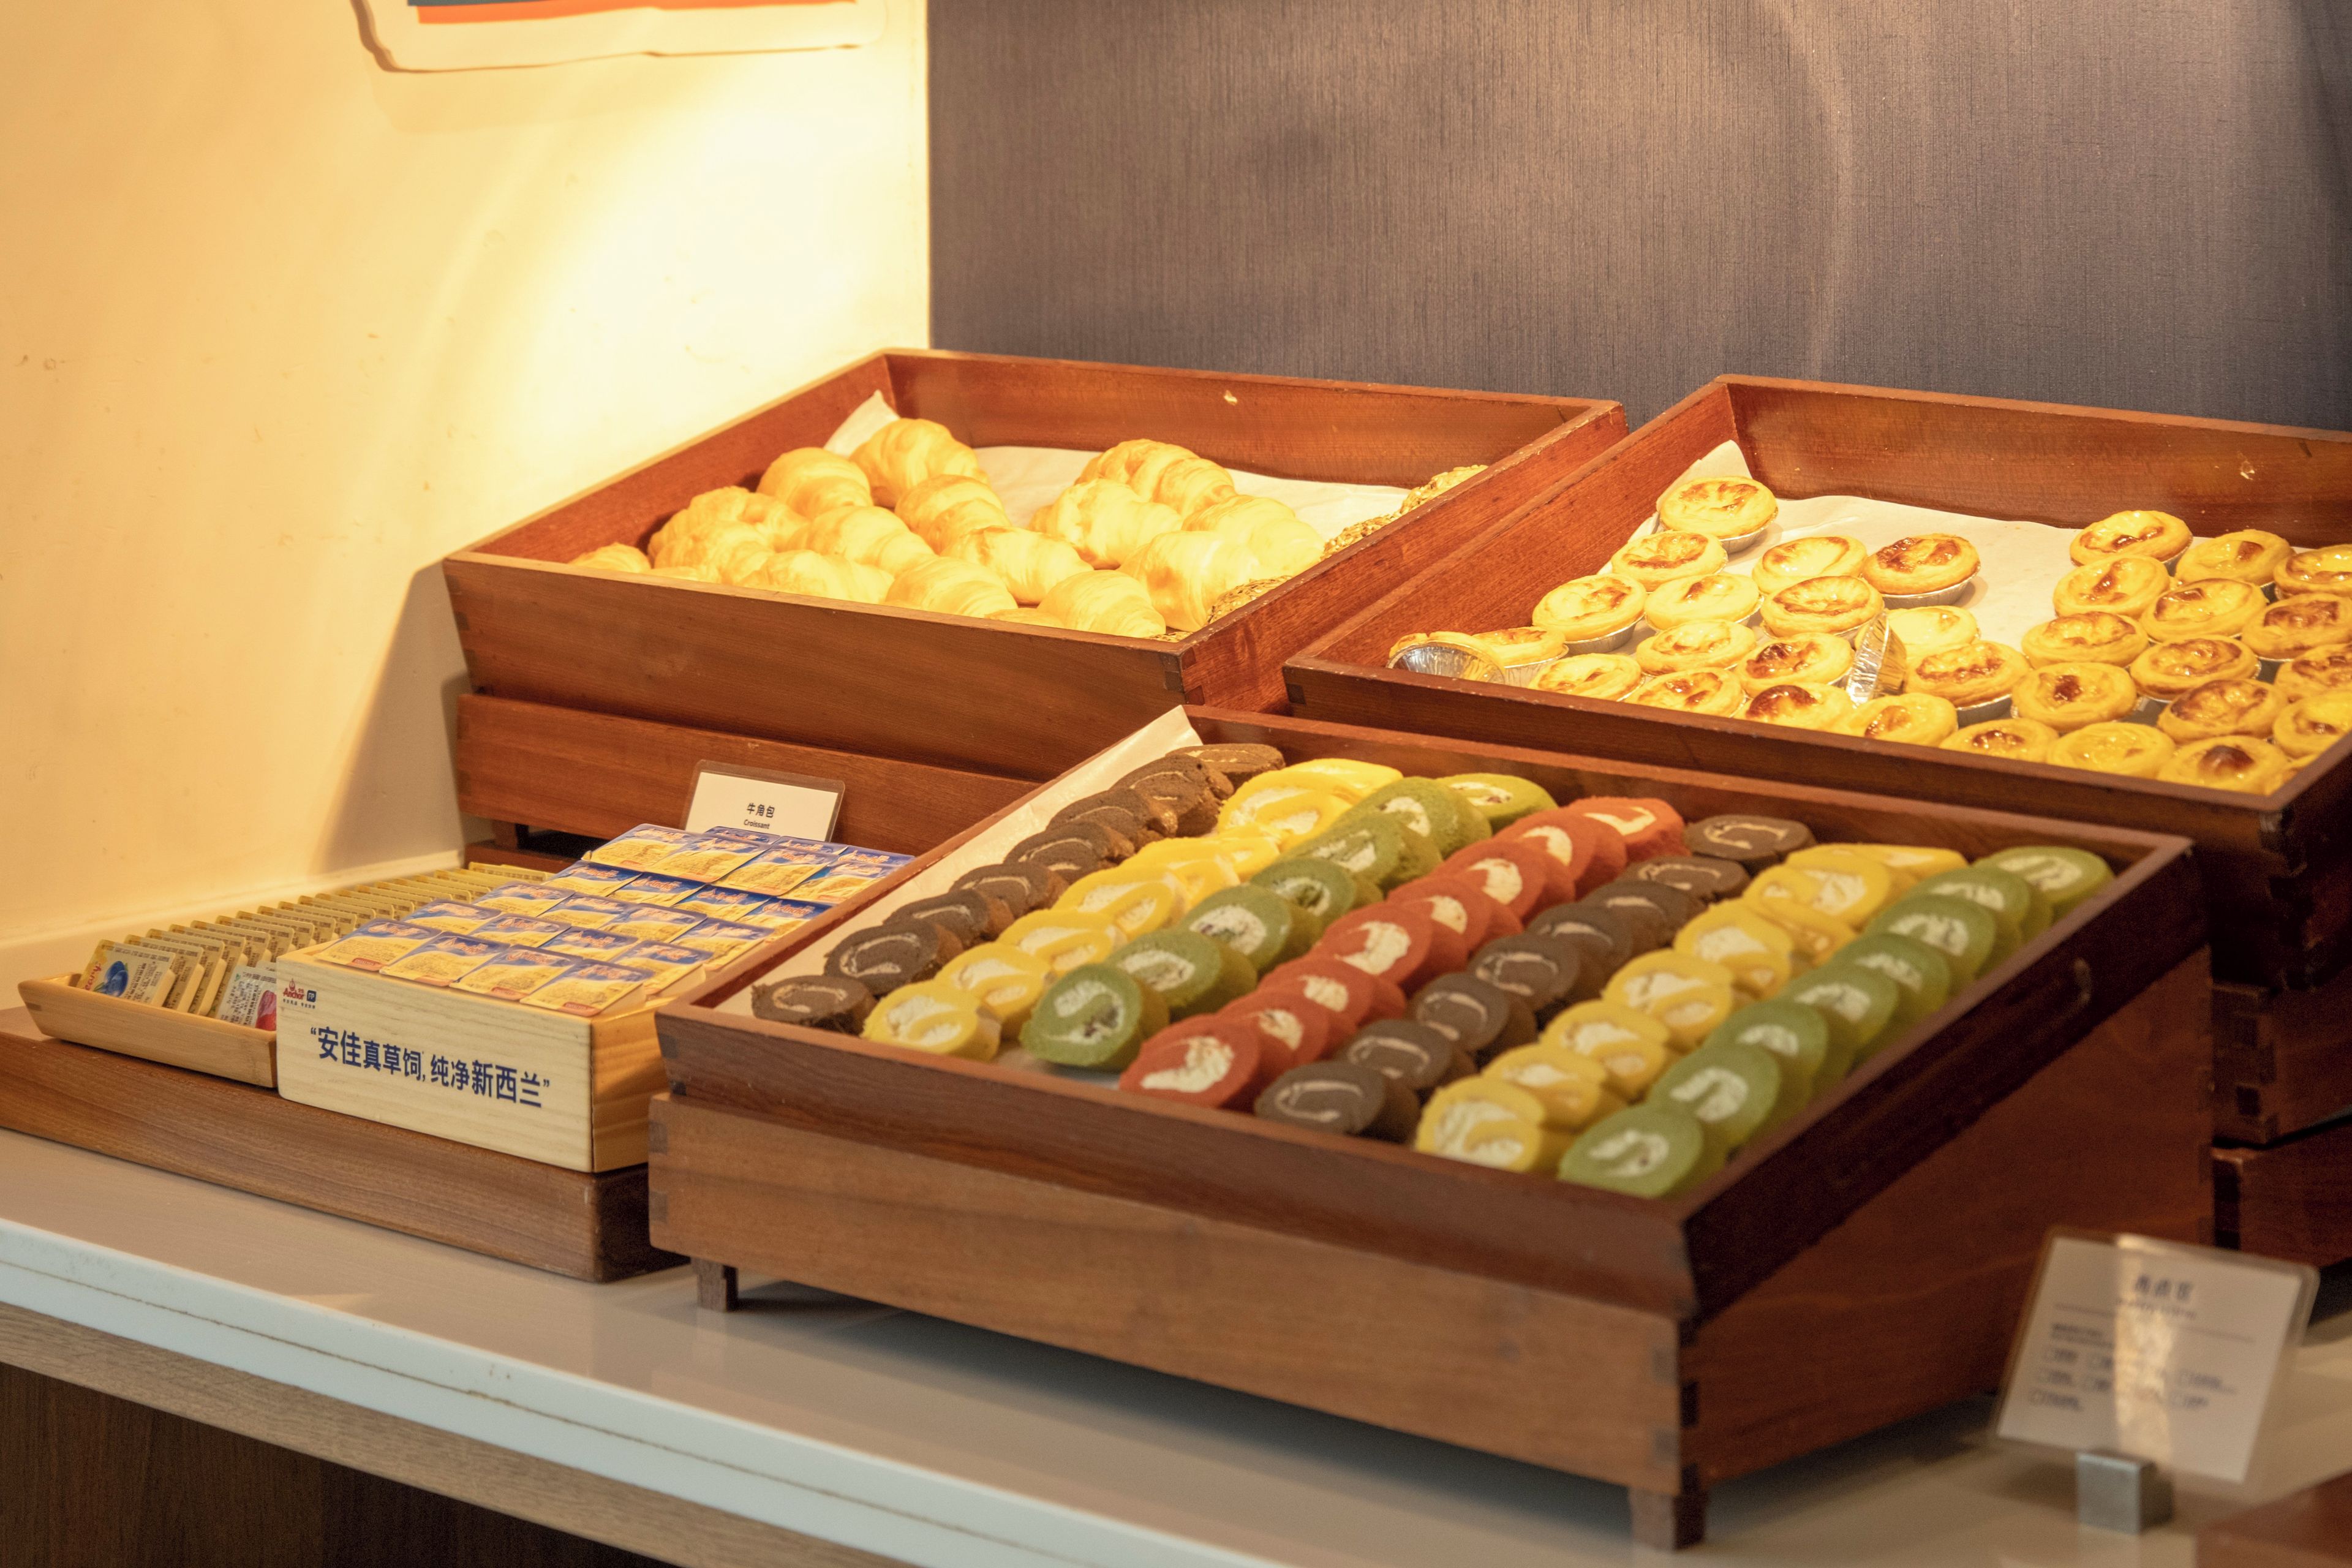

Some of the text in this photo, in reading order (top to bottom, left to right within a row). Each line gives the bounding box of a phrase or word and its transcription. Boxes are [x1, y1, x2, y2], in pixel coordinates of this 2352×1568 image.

[747, 802, 775, 818] 牛角包
[744, 819, 770, 829] Croissant
[283, 987, 304, 1000] Anchor
